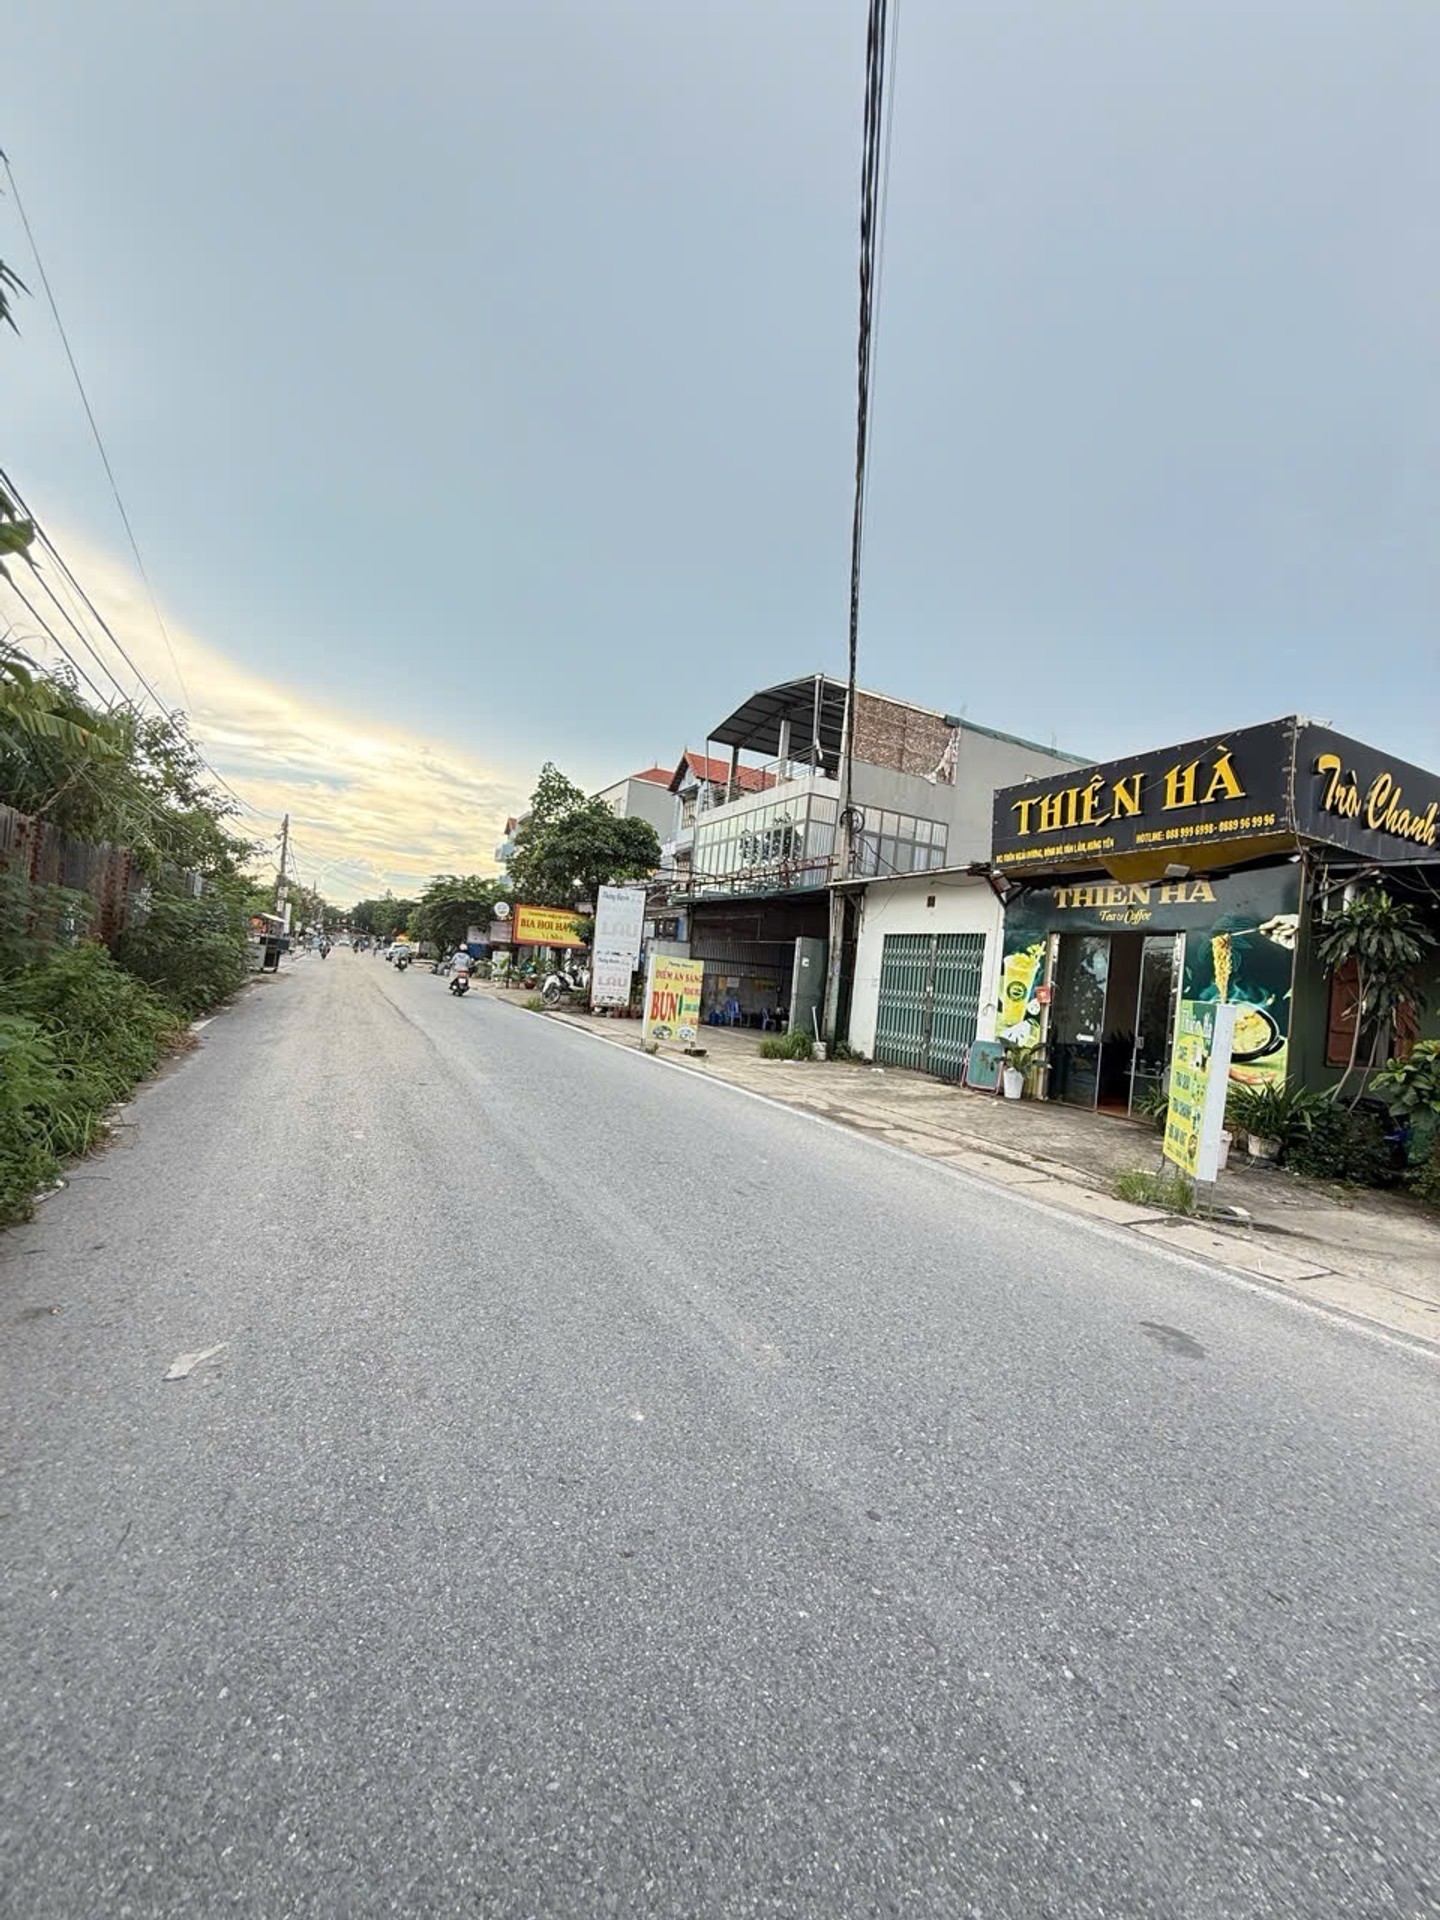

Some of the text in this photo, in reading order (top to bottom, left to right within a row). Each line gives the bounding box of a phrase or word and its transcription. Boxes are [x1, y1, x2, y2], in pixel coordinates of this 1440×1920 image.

[1011, 745, 1246, 836] THIÊN HÀ
[1316, 754, 1439, 848] Trà Chanh
[520, 918, 535, 928] BIA
[1099, 910, 1115, 922] Tea
[1123, 909, 1152, 925] Coffee
[650, 983, 679, 1022] BÚN
